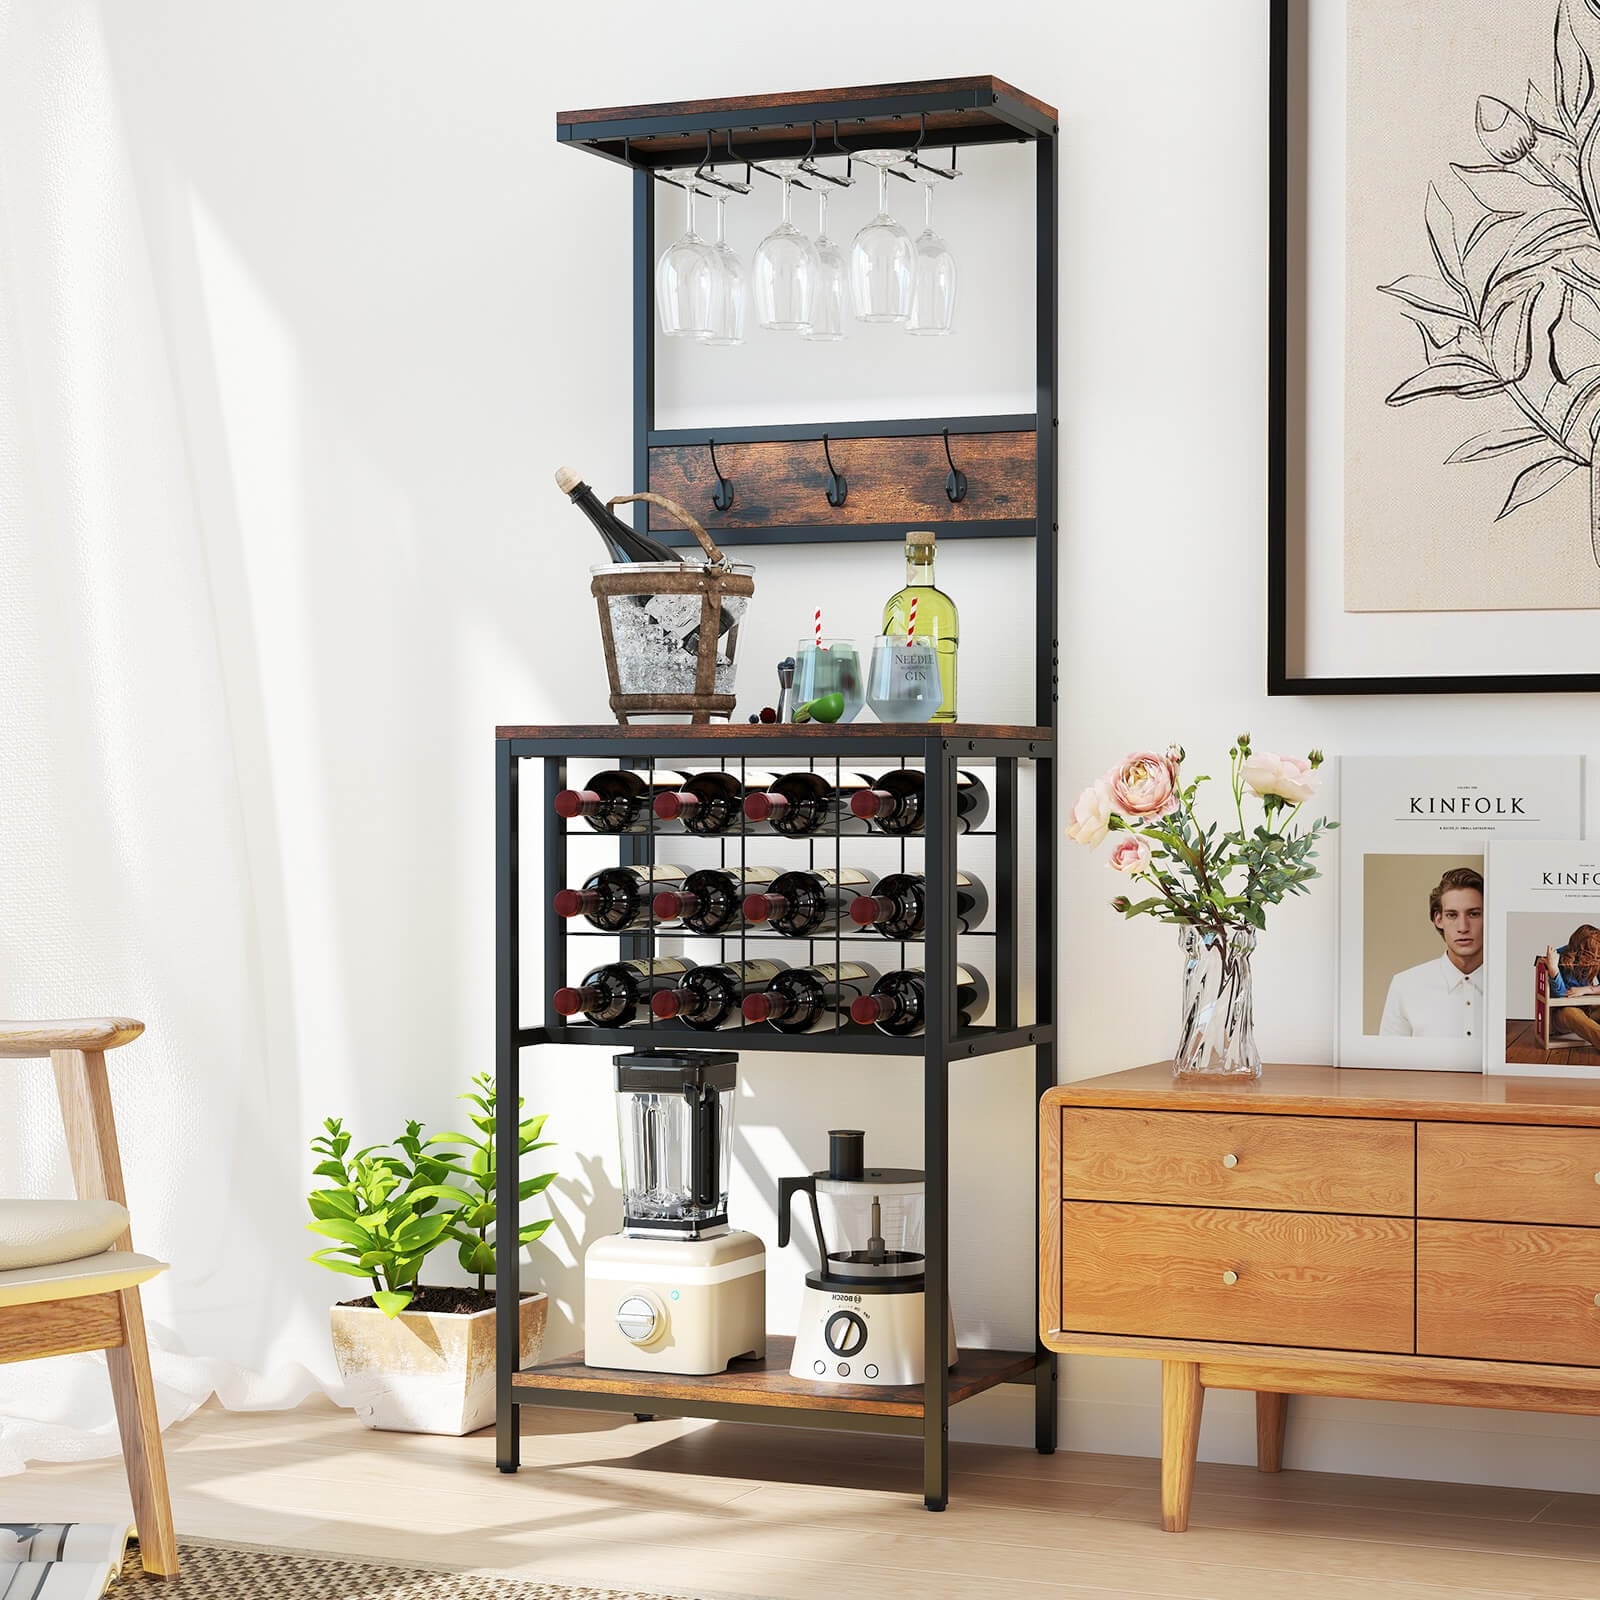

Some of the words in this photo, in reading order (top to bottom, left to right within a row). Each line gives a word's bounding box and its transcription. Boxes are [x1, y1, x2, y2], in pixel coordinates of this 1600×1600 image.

[895, 654, 935, 664] NEEDLE
[904, 671, 927, 681] GIN
[1409, 797, 1526, 814] KINFOLK
